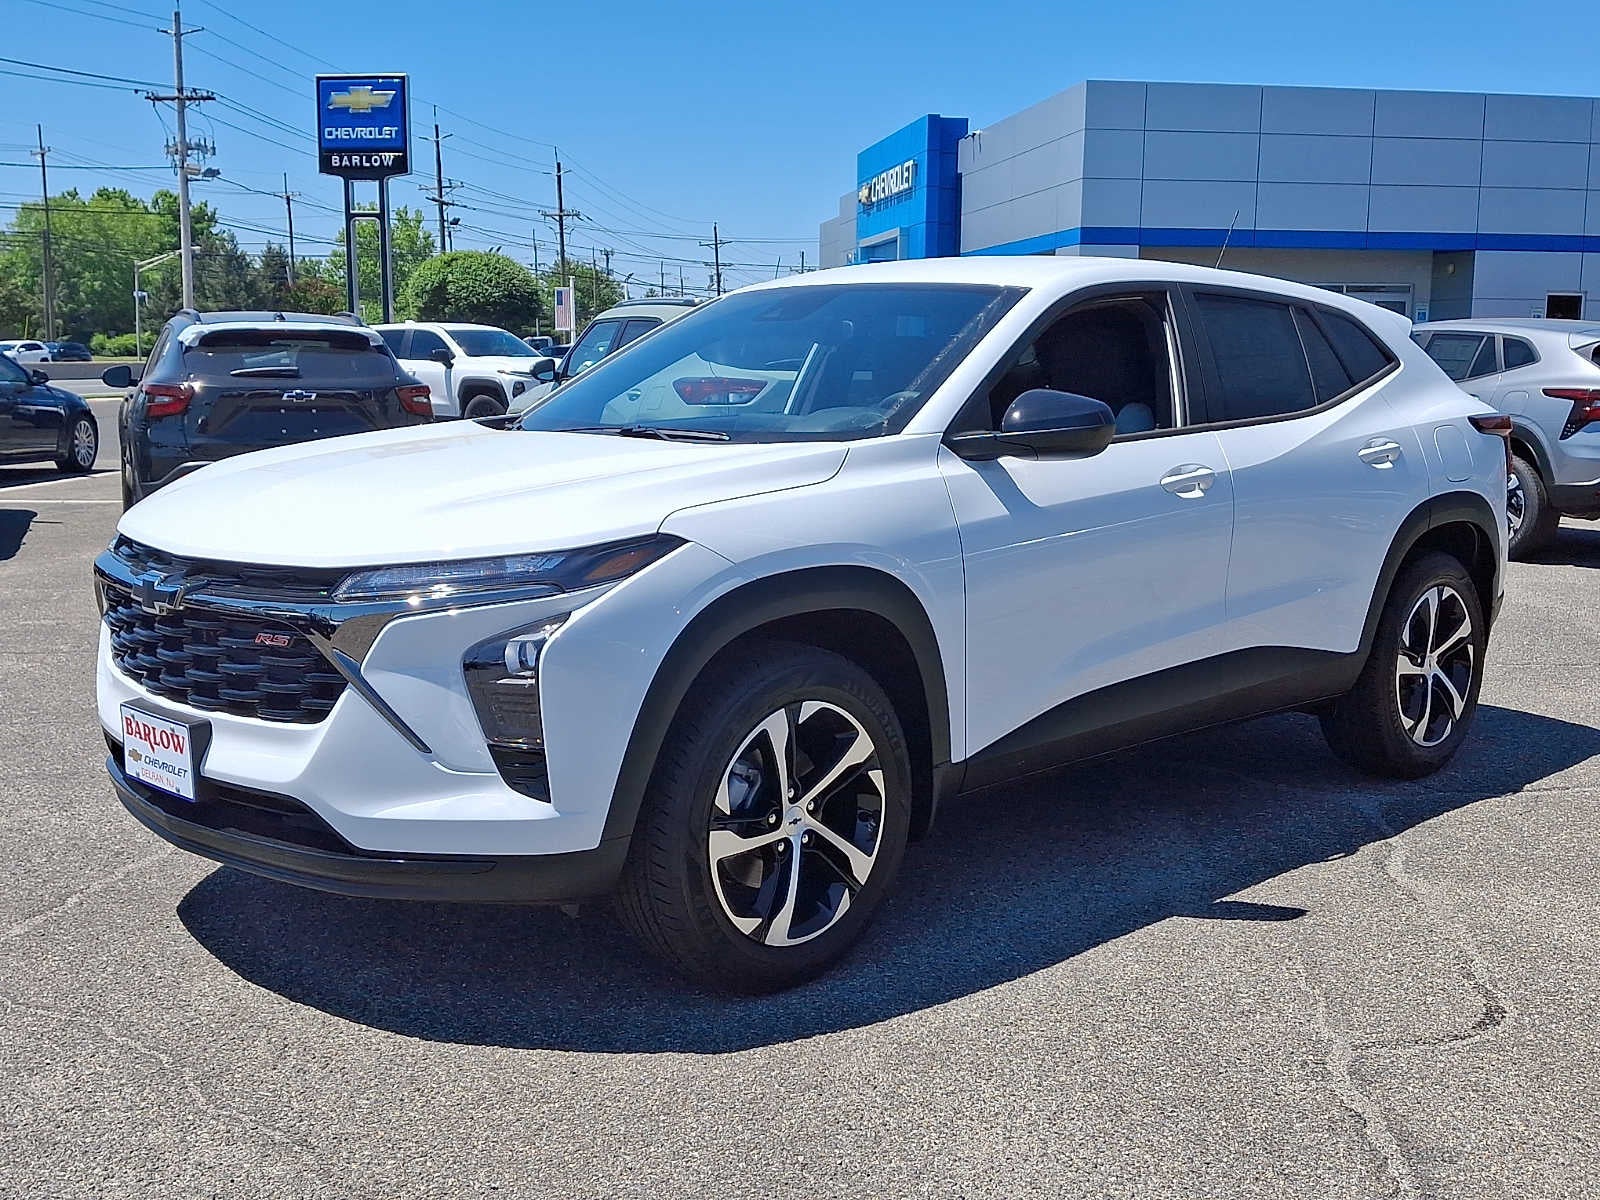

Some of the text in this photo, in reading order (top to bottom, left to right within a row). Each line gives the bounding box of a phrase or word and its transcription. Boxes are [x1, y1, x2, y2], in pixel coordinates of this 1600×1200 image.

[325, 127, 398, 139] CHEVROLET
[331, 155, 394, 167] BARLOW
[871, 159, 914, 202] CHEVROLET
[255, 632, 290, 647] RS
[124, 716, 185, 754] BARLOW
[144, 755, 188, 778] CHEVROLET
